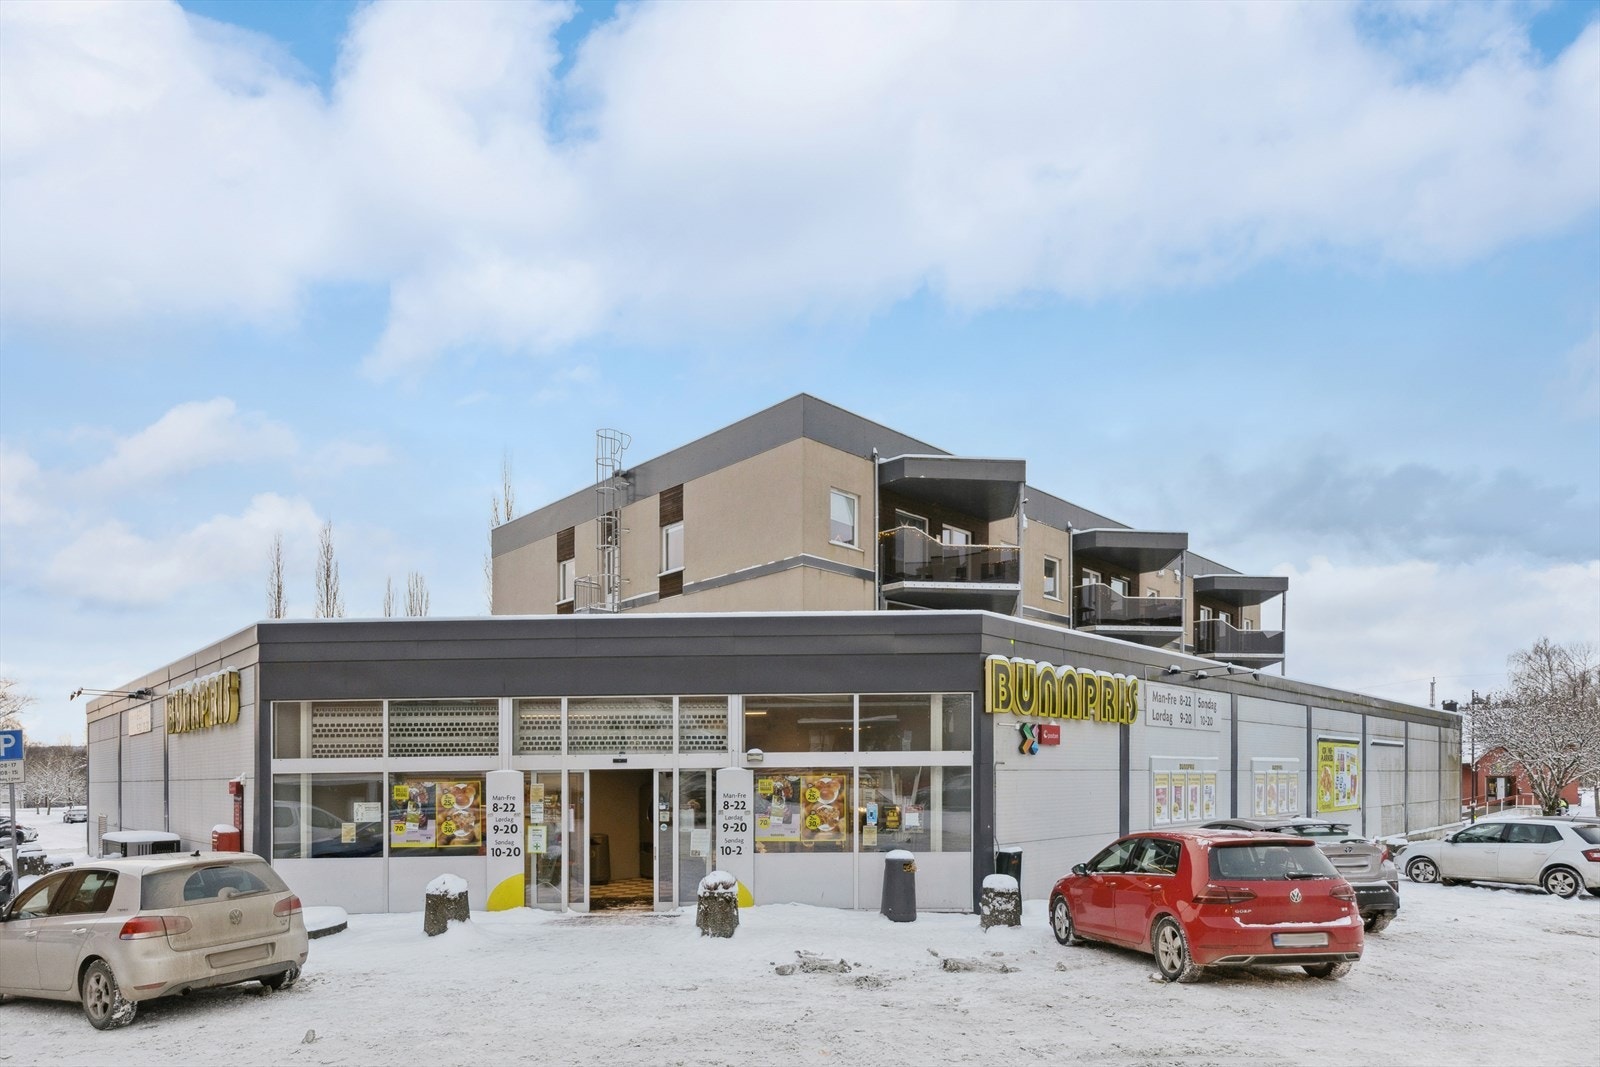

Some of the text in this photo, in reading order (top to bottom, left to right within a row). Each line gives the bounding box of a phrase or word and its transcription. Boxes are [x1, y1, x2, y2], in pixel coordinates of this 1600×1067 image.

[984, 658, 1138, 724] BUNNPRIS
[1152, 691, 1192, 707] Man-Fre 8-22
[1152, 709, 1192, 726] Lørdag 9-20
[1200, 715, 1214, 726] 10-20
[0, 735, 16, 756] P
[492, 803, 516, 813] 8-22
[723, 800, 746, 810] 8-22
[493, 824, 518, 834] 9-20
[722, 822, 747, 832] 9-20
[491, 847, 521, 857] 10-20
[720, 846, 742, 855] 10-2
